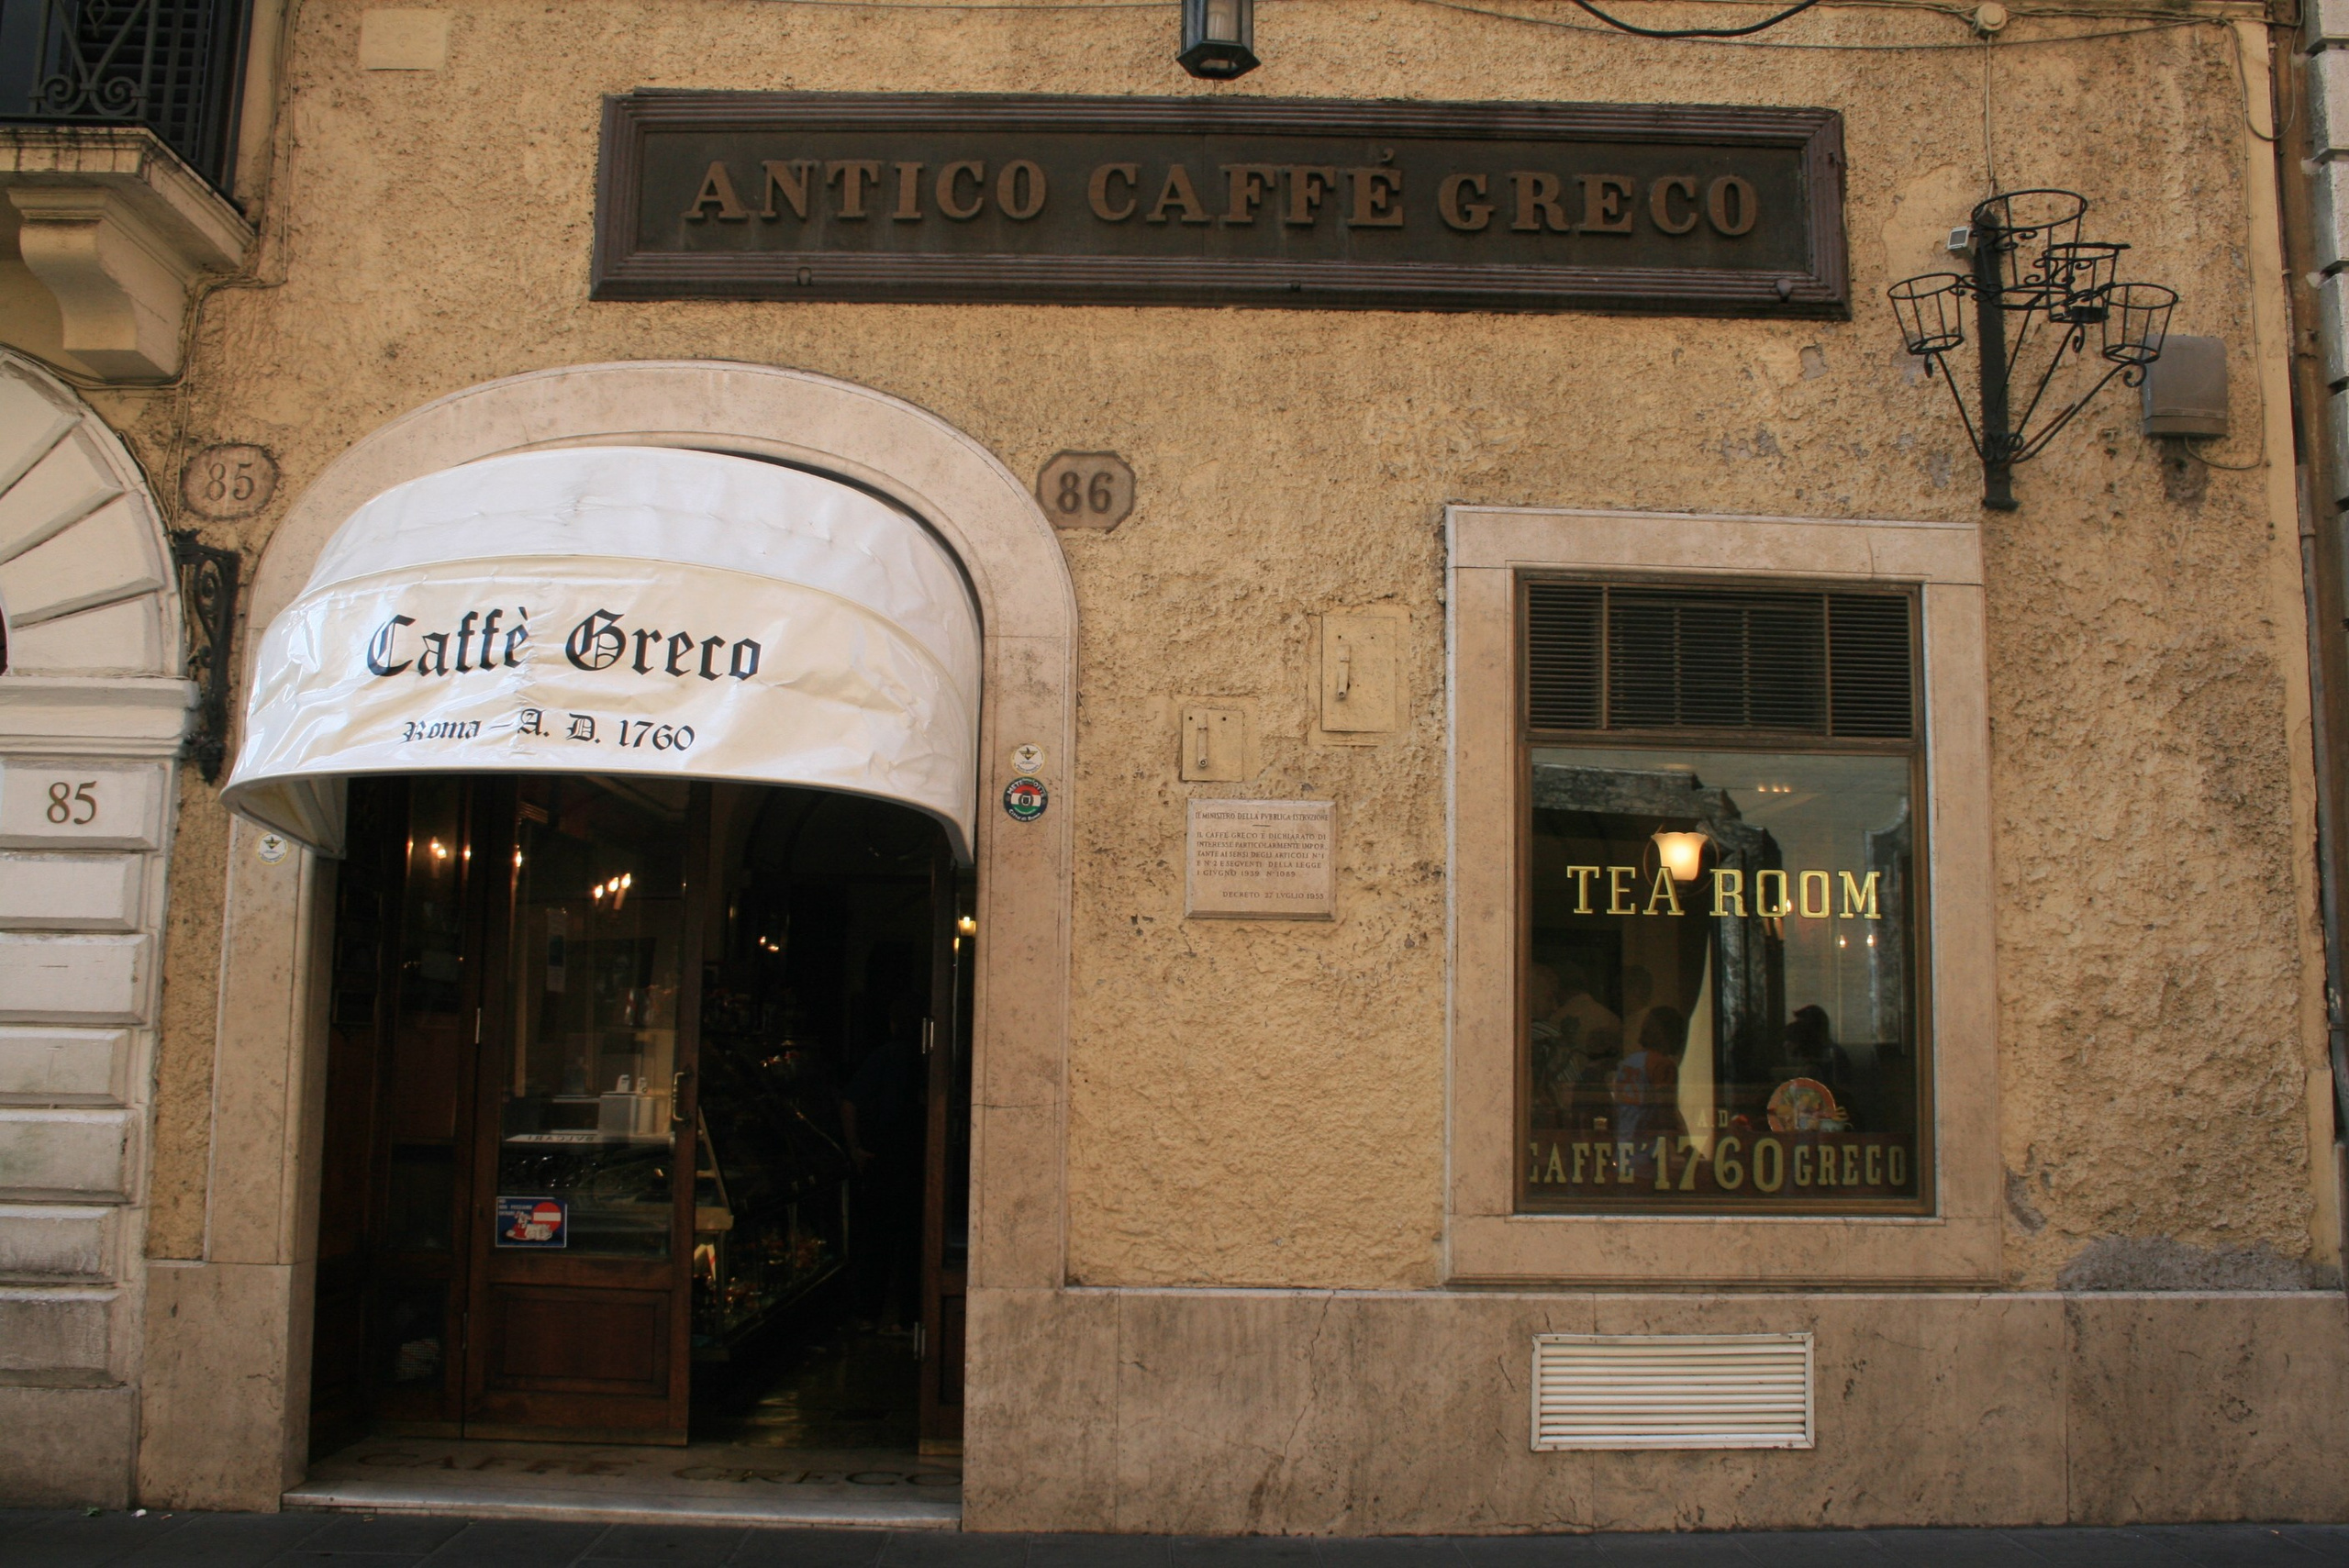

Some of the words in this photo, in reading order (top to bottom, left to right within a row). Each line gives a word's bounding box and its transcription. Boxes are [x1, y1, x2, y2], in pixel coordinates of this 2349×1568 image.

[685, 159, 1047, 222] ANTICO
[1438, 171, 1759, 237] GRECO
[204, 462, 255, 502] 85
[1057, 471, 1114, 515] 86
[564, 607, 763, 681] Greco
[401, 719, 482, 745] Roma
[517, 707, 551, 738] A.
[567, 712, 601, 744] D.
[618, 719, 696, 751] 1760
[46, 781, 98, 826] 85
[1237, 812, 1259, 820] DELLA
[1235, 841, 1300, 850] PARTICOLARMENTE
[1566, 865, 1685, 916] TEA
[1709, 868, 1882, 920] ROOM
[1652, 1135, 1784, 1193] 1760
[1794, 1144, 1907, 1186] GRECO
